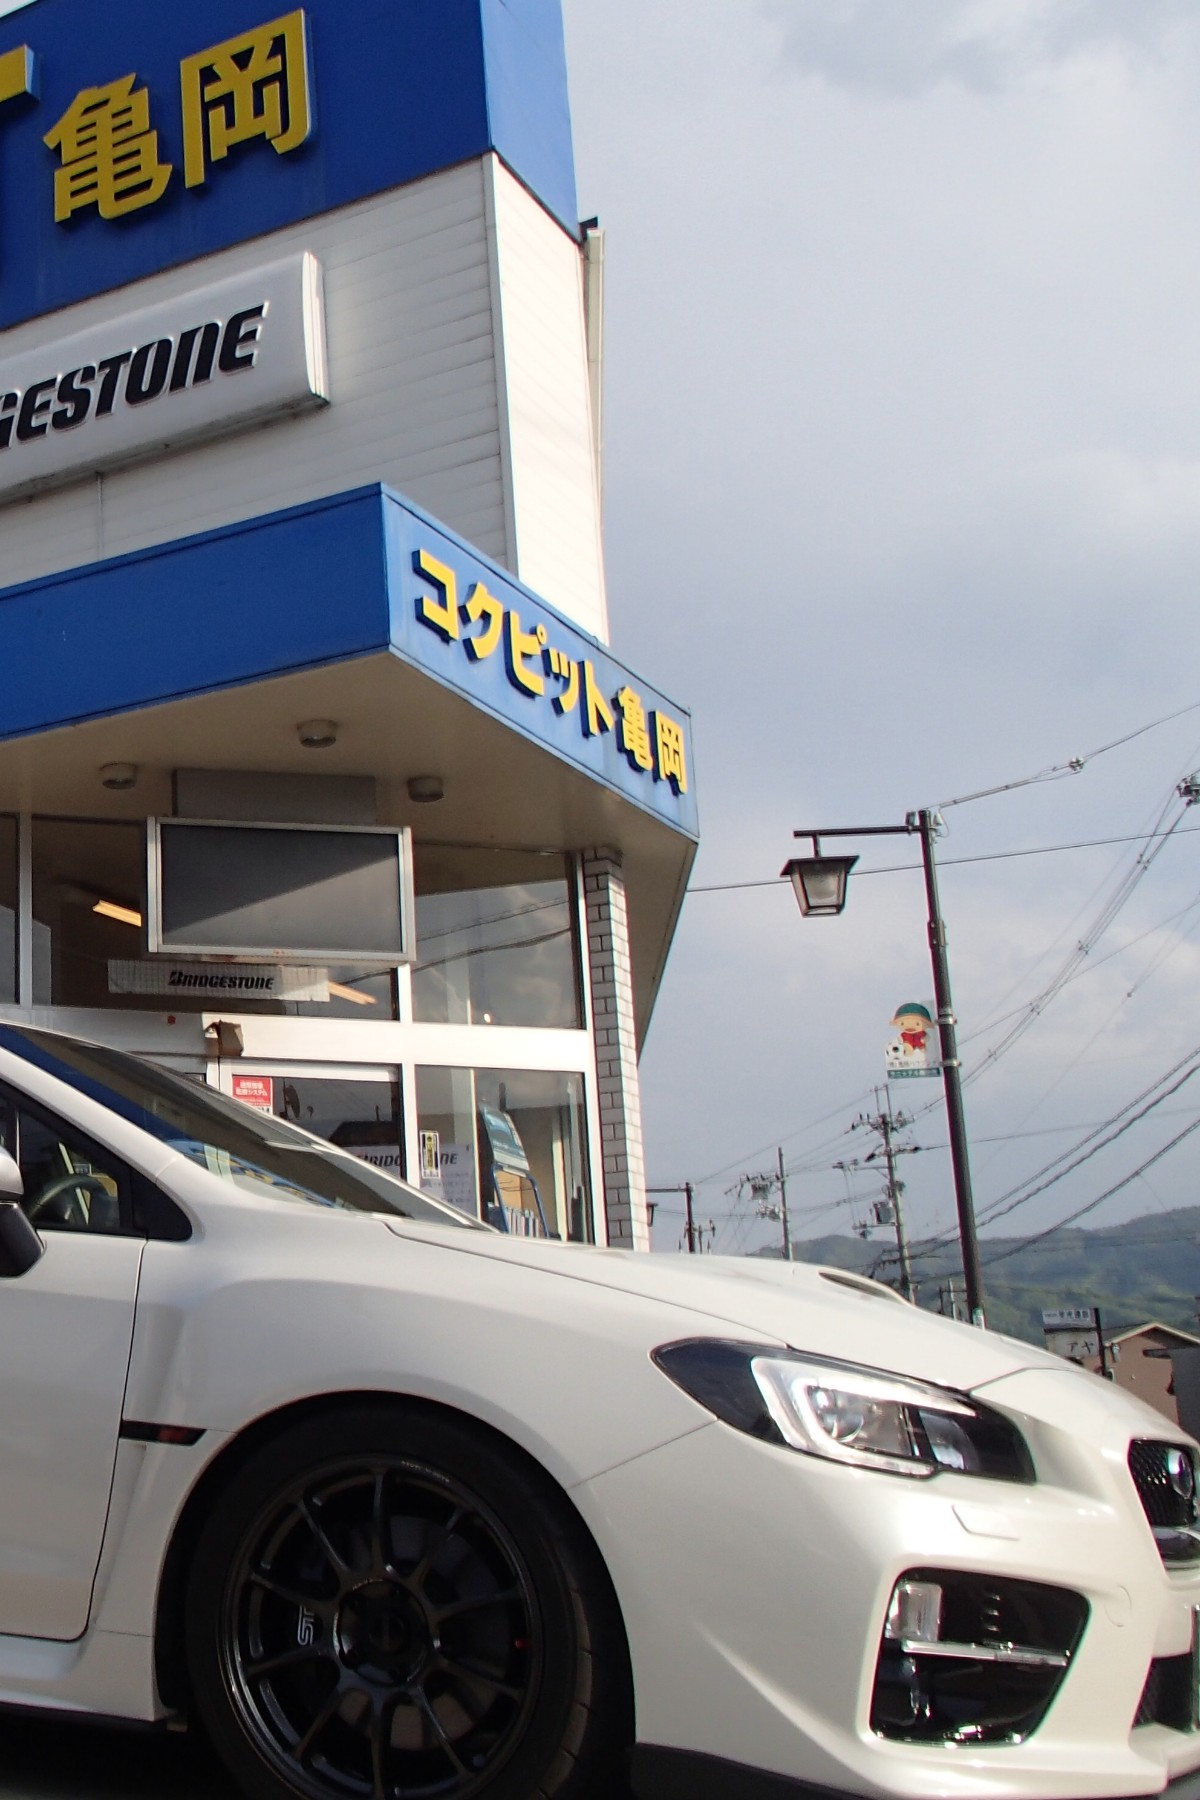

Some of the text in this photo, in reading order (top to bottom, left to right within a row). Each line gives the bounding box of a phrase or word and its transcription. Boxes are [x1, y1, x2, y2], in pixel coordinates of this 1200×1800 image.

[43, 8, 313, 225] 亀岡
[412, 549, 688, 796] コクピット亀岡
[168, 970, 275, 990] BRIDGESTONE
